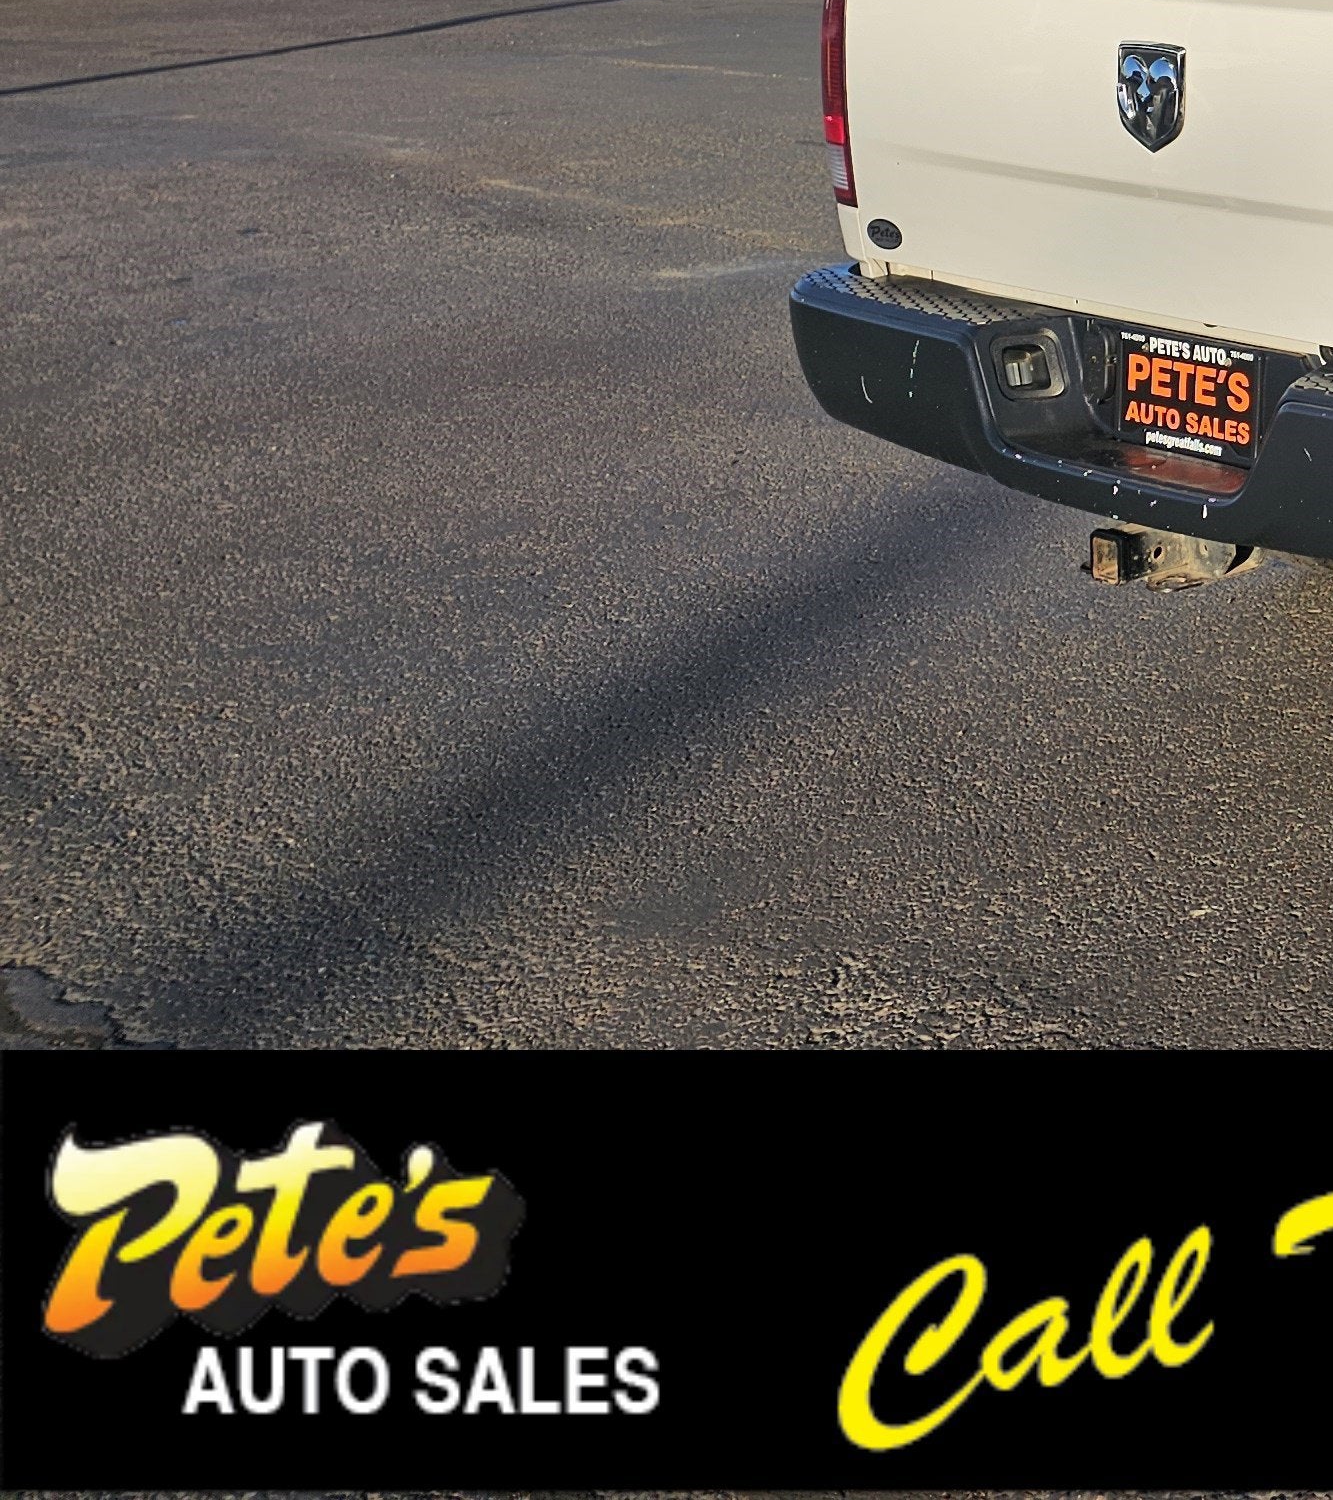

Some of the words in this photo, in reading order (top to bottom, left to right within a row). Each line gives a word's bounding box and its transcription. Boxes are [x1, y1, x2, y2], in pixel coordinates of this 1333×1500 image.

[1149, 336, 1191, 360] PETE'S
[1192, 344, 1227, 366] AUTO
[1127, 353, 1250, 413] PETE'S
[1125, 400, 1181, 430] AUTO
[1185, 412, 1250, 445] SALES
[1145, 430, 1223, 457] petesgreatfalls.com
